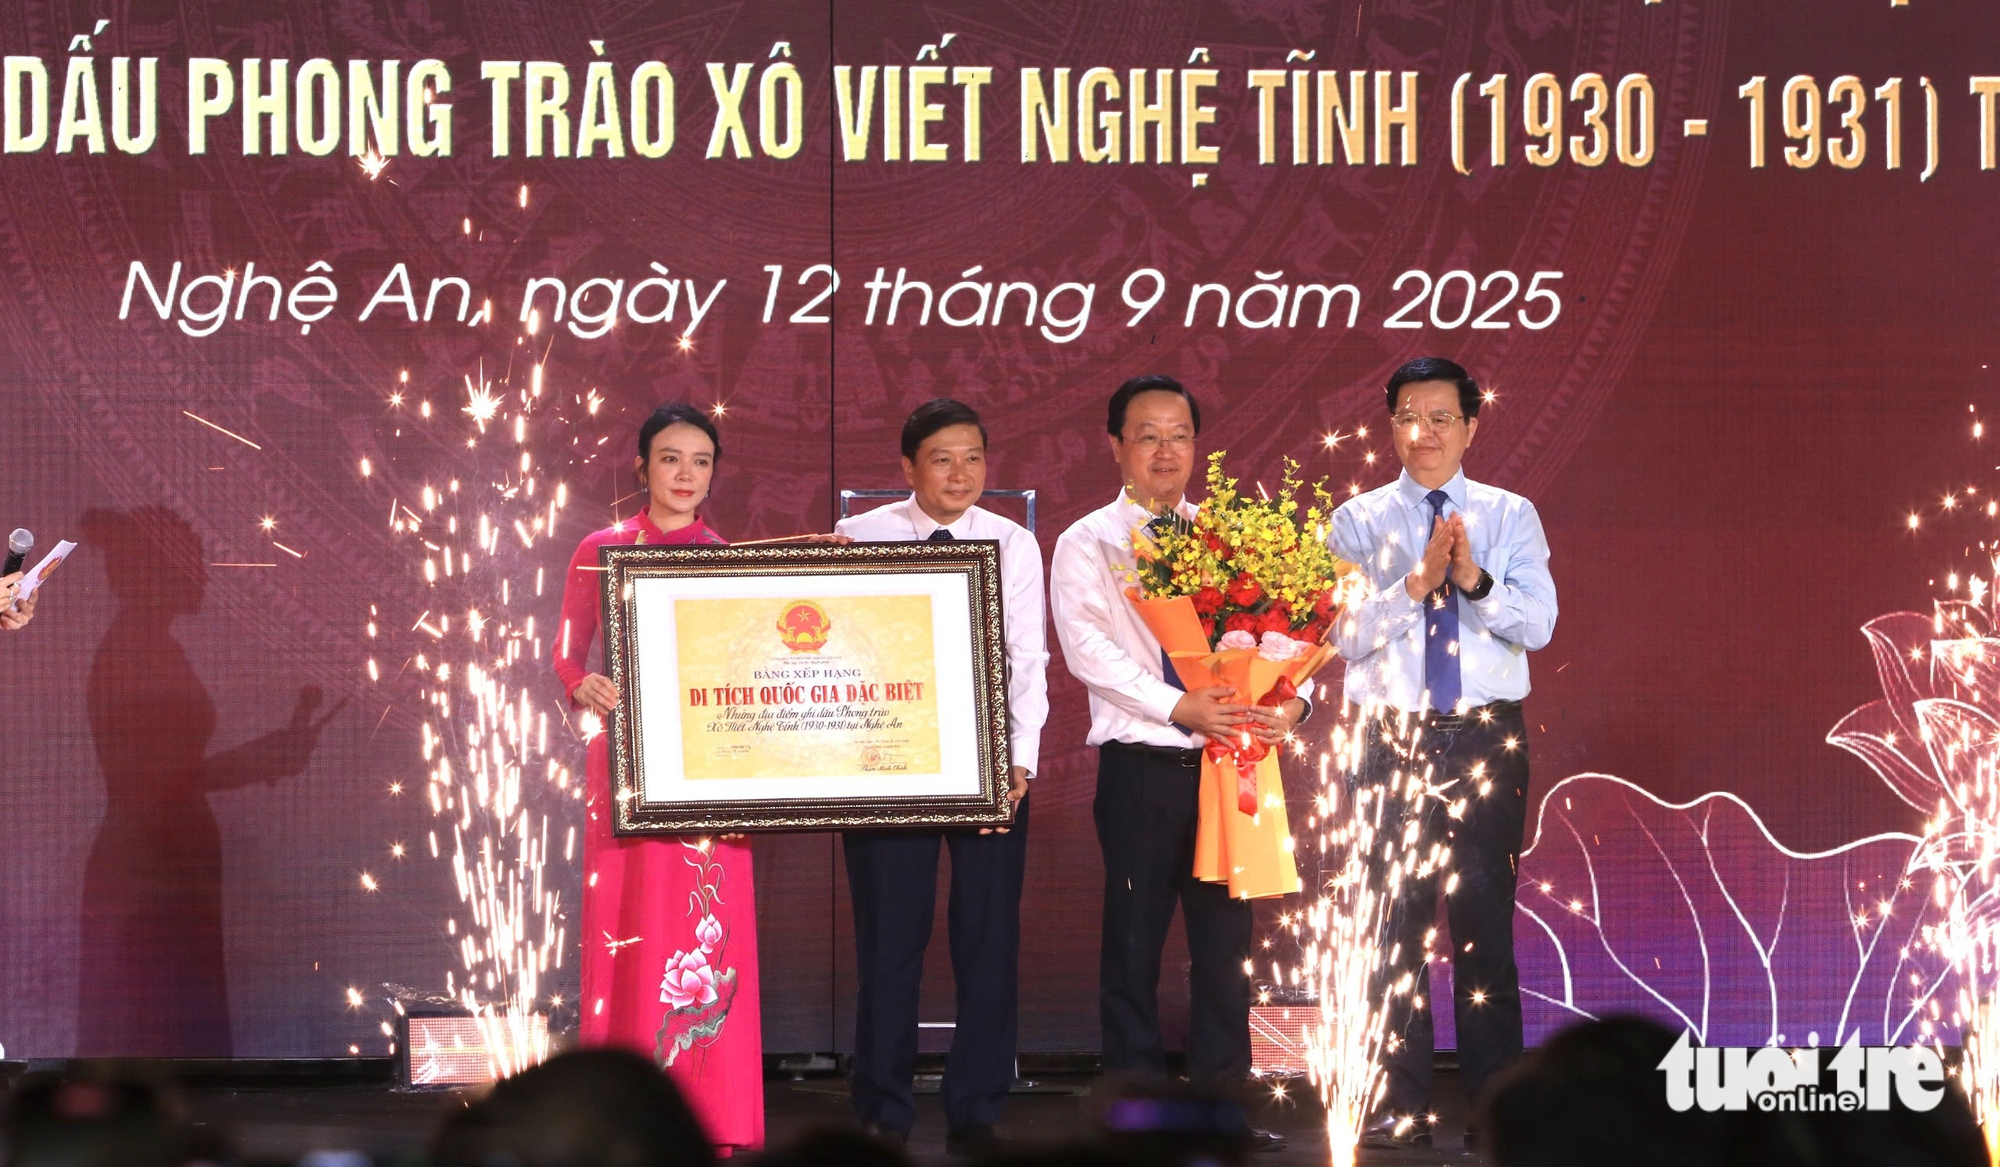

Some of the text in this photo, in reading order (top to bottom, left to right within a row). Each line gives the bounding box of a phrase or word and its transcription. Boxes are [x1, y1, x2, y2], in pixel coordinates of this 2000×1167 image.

[3, 19, 159, 155] DẤU
[188, 58, 453, 158] PHONG
[480, 40, 675, 159] TRÀO
[705, 41, 804, 160] XÔ
[834, 33, 993, 163] VIẾT
[1020, 48, 1220, 188] NGHỆ
[1247, 49, 1419, 167] TĨNH
[1450, 72, 1655, 176] (1930
[1738, 75, 1939, 183] 1931)
[118, 260, 1564, 344] Nghệ An, ngày 12 tháng 9 năm 2025
[793, 667, 820, 679] XẾP
[823, 668, 862, 680] HẠNG
[689, 679, 924, 707] DI TÍCH QUỐC GIA ĐẶC BIỆT
[836, 704, 869, 719] Phong
[886, 717, 904, 729] An
